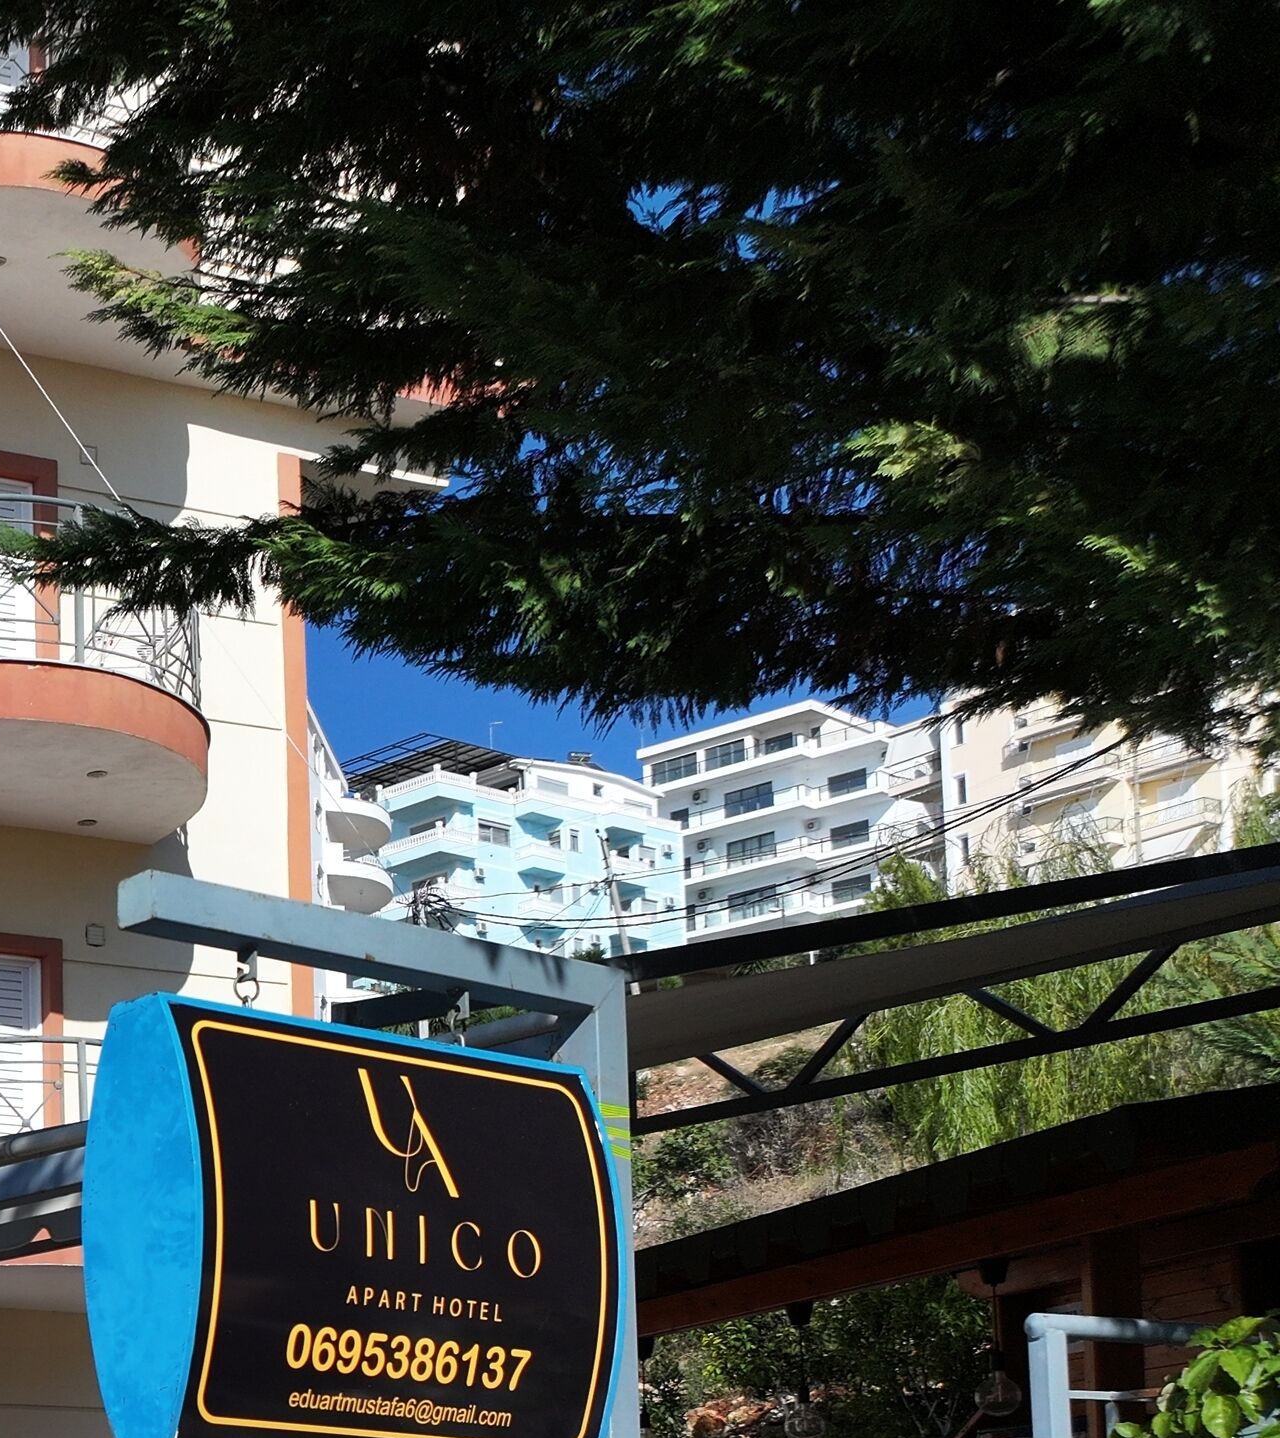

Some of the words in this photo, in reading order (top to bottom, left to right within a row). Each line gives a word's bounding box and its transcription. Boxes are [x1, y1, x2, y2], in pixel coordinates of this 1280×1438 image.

[309, 1199, 541, 1279] UNICO
[346, 1285, 421, 1313] APART
[433, 1296, 503, 1323] HOTEL
[286, 1323, 532, 1392] 0695386137
[288, 1388, 512, 1429] eduartmustafa6@gmail.com
